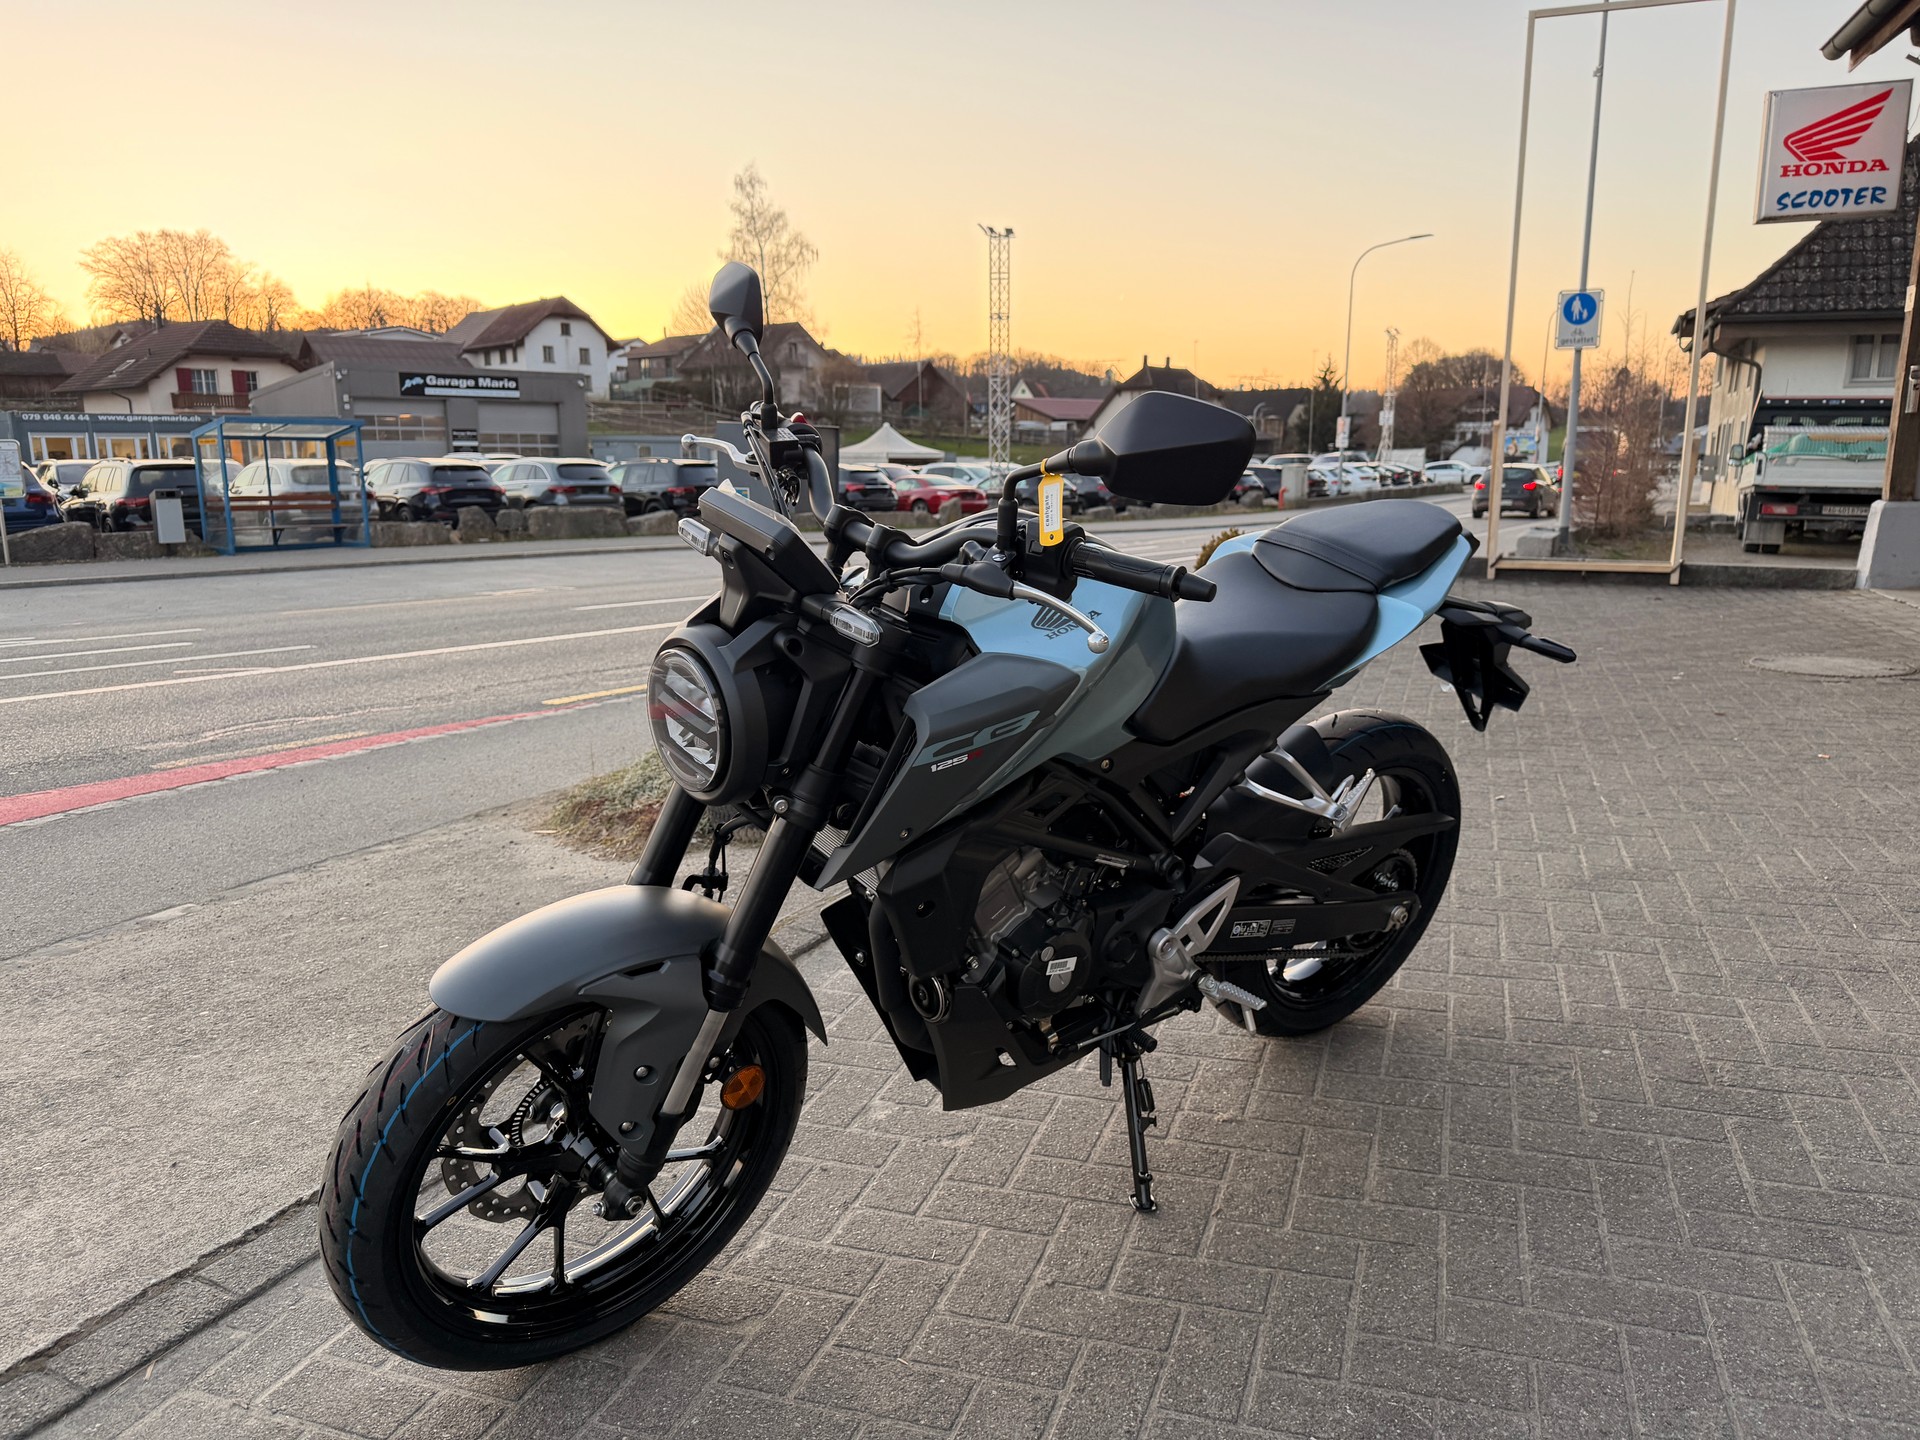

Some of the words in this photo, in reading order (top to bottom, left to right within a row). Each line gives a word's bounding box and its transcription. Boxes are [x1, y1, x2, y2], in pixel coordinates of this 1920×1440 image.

[1780, 158, 1890, 178] HONDA
[1776, 186, 1887, 211] SCOOTER
[425, 375, 476, 389] Garage
[477, 377, 517, 389] Mario
[22, 413, 41, 421] 079
[43, 413, 61, 421] 646
[97, 414, 202, 423] www.garage-mario.ch
[1044, 610, 1103, 640] HONA
